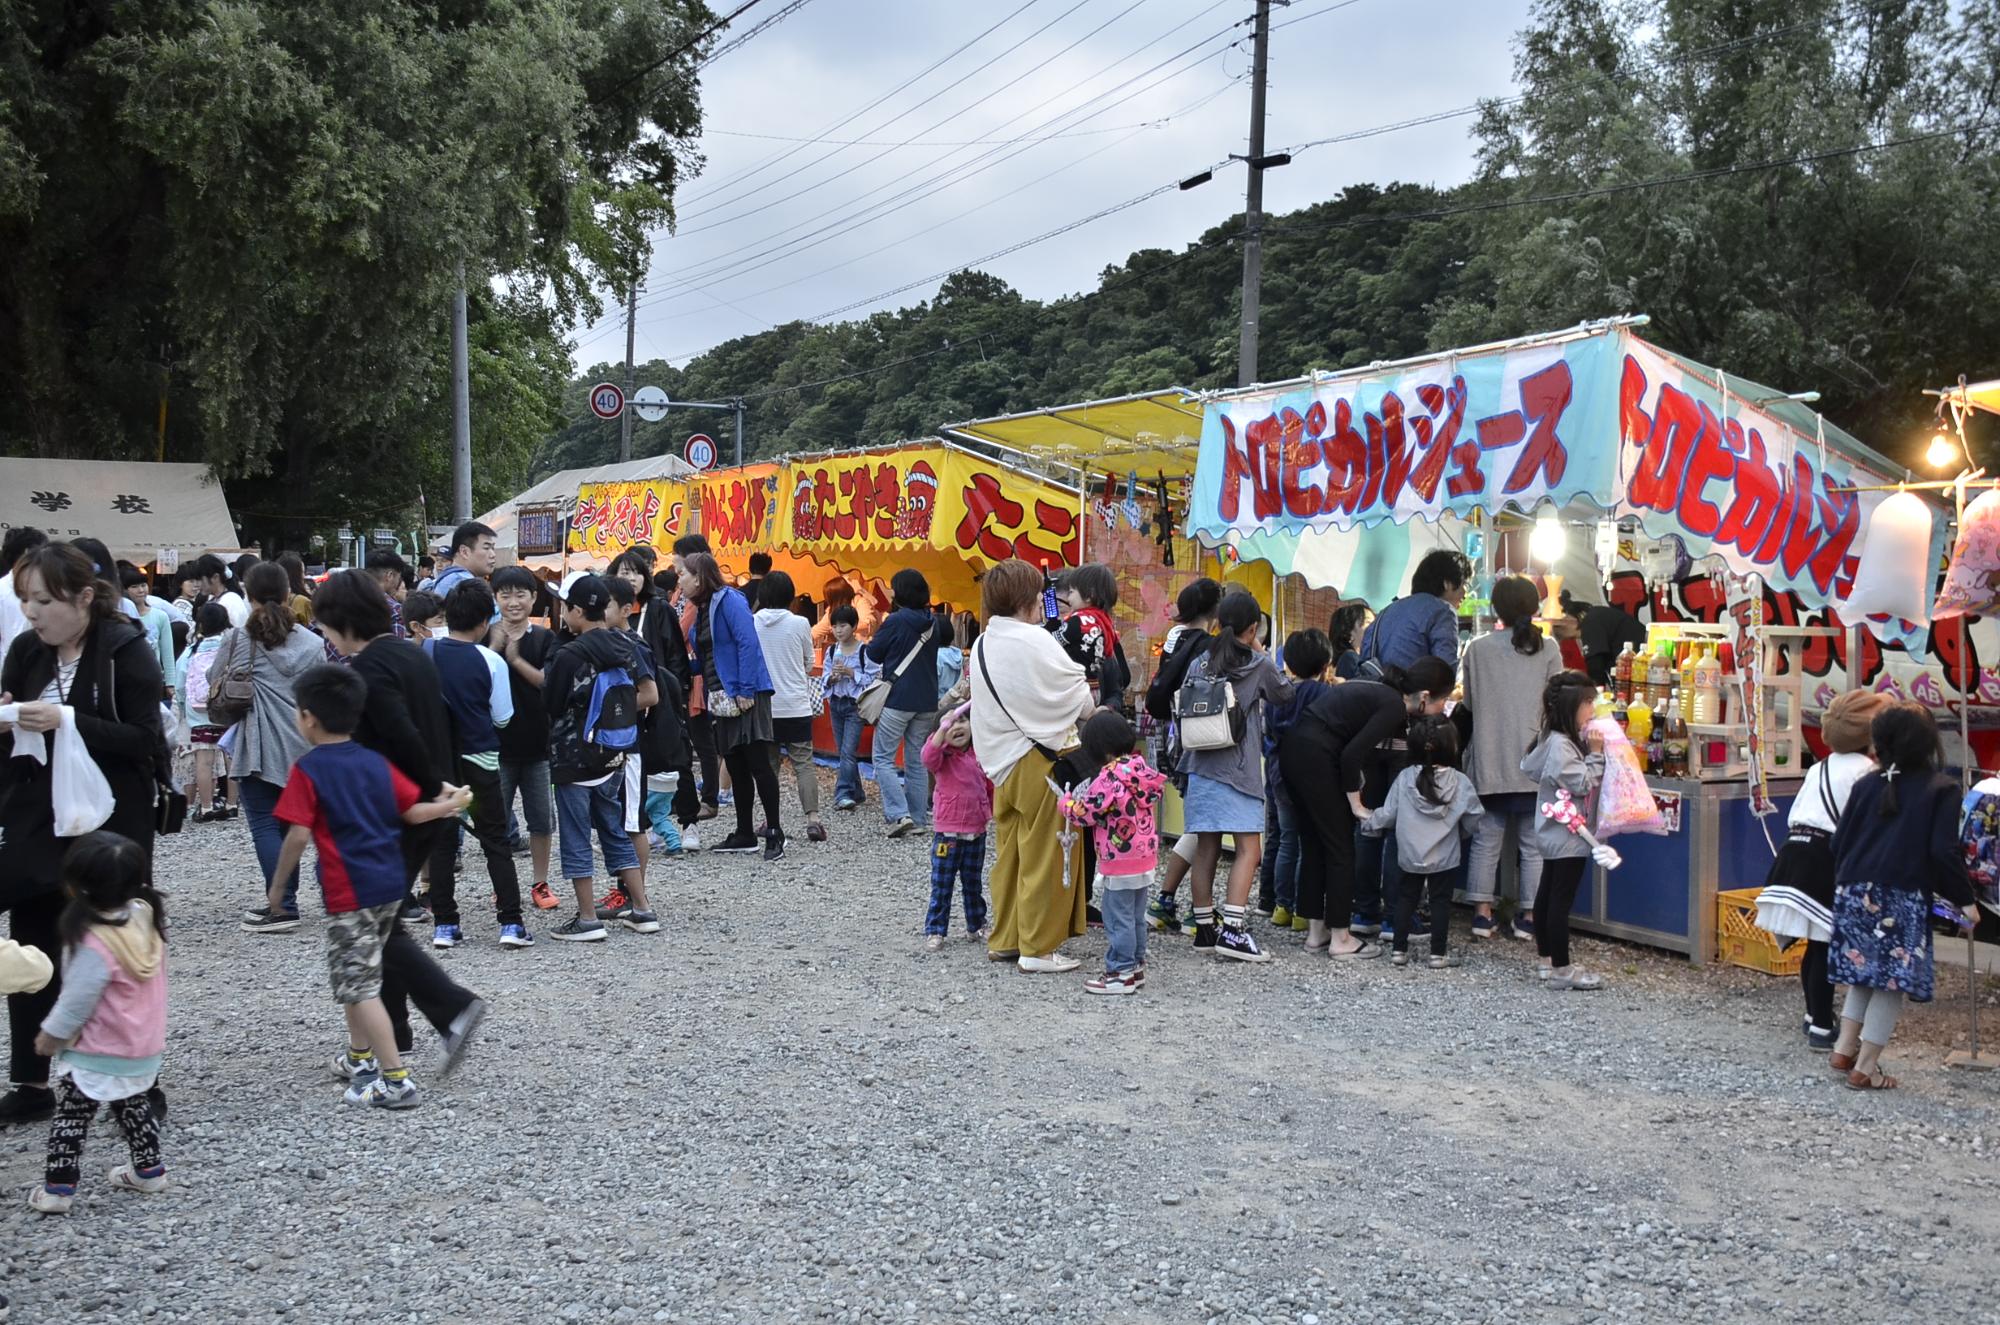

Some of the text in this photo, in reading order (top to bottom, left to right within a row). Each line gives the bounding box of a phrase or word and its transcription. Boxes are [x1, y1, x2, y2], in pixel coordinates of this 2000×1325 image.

[597, 393, 616, 408] 40
[692, 446, 711, 464] 40
[1217, 358, 1574, 523] トロピカルジュース
[30, 490, 154, 514] 学校
[571, 488, 661, 546] やきそば
[700, 477, 766, 547] からあげ
[813, 461, 900, 541] たこやき
[1916, 683, 1940, 704] AB
